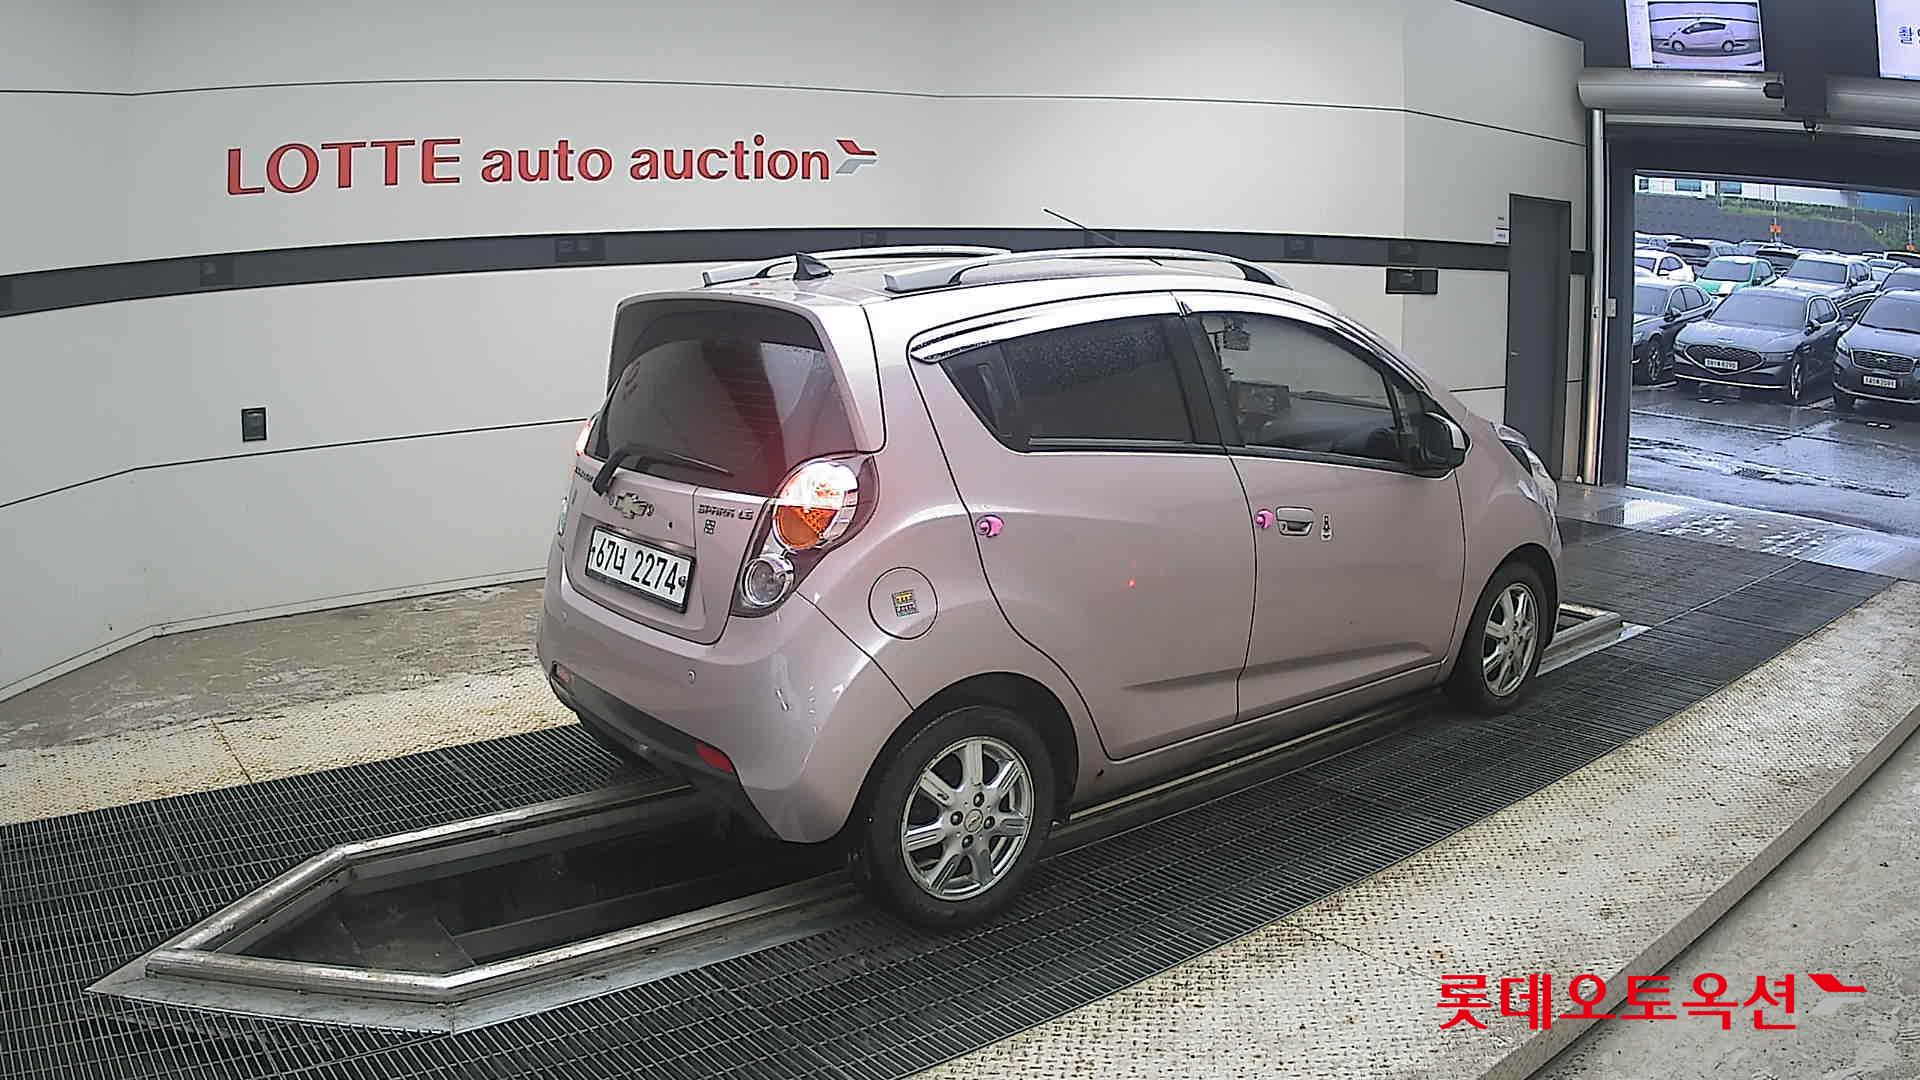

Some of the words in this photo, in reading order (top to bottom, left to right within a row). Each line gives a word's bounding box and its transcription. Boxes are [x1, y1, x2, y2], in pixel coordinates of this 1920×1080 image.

[227, 138, 461, 195] LOTTE
[481, 139, 613, 184] auto
[630, 133, 831, 181] auction
[595, 537, 626, 576] 67너
[630, 549, 680, 595] 2274
